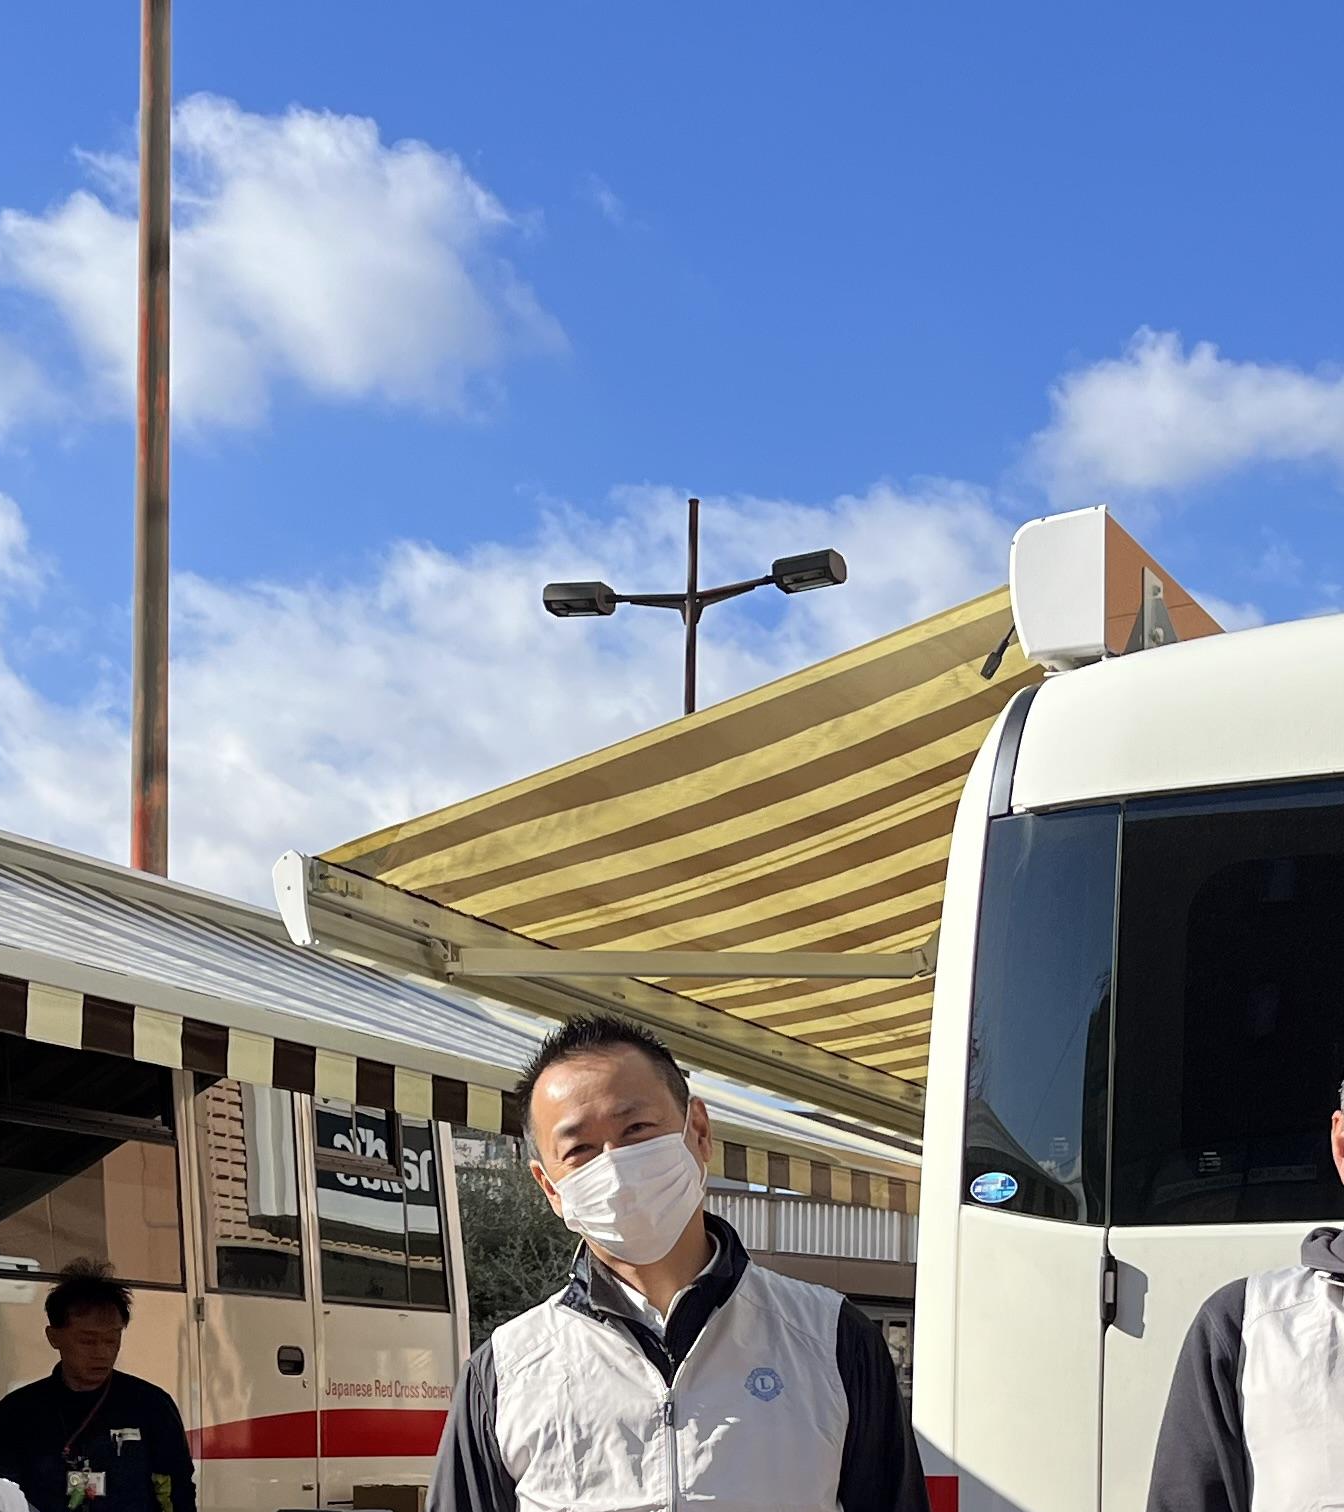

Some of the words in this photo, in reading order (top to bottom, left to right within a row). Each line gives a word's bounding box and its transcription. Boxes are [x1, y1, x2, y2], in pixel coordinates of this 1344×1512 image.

[324, 1377, 372, 1400] Japanese
[374, 1379, 393, 1398] Red
[394, 1380, 420, 1399] Cross
[422, 1381, 454, 1403] Society
